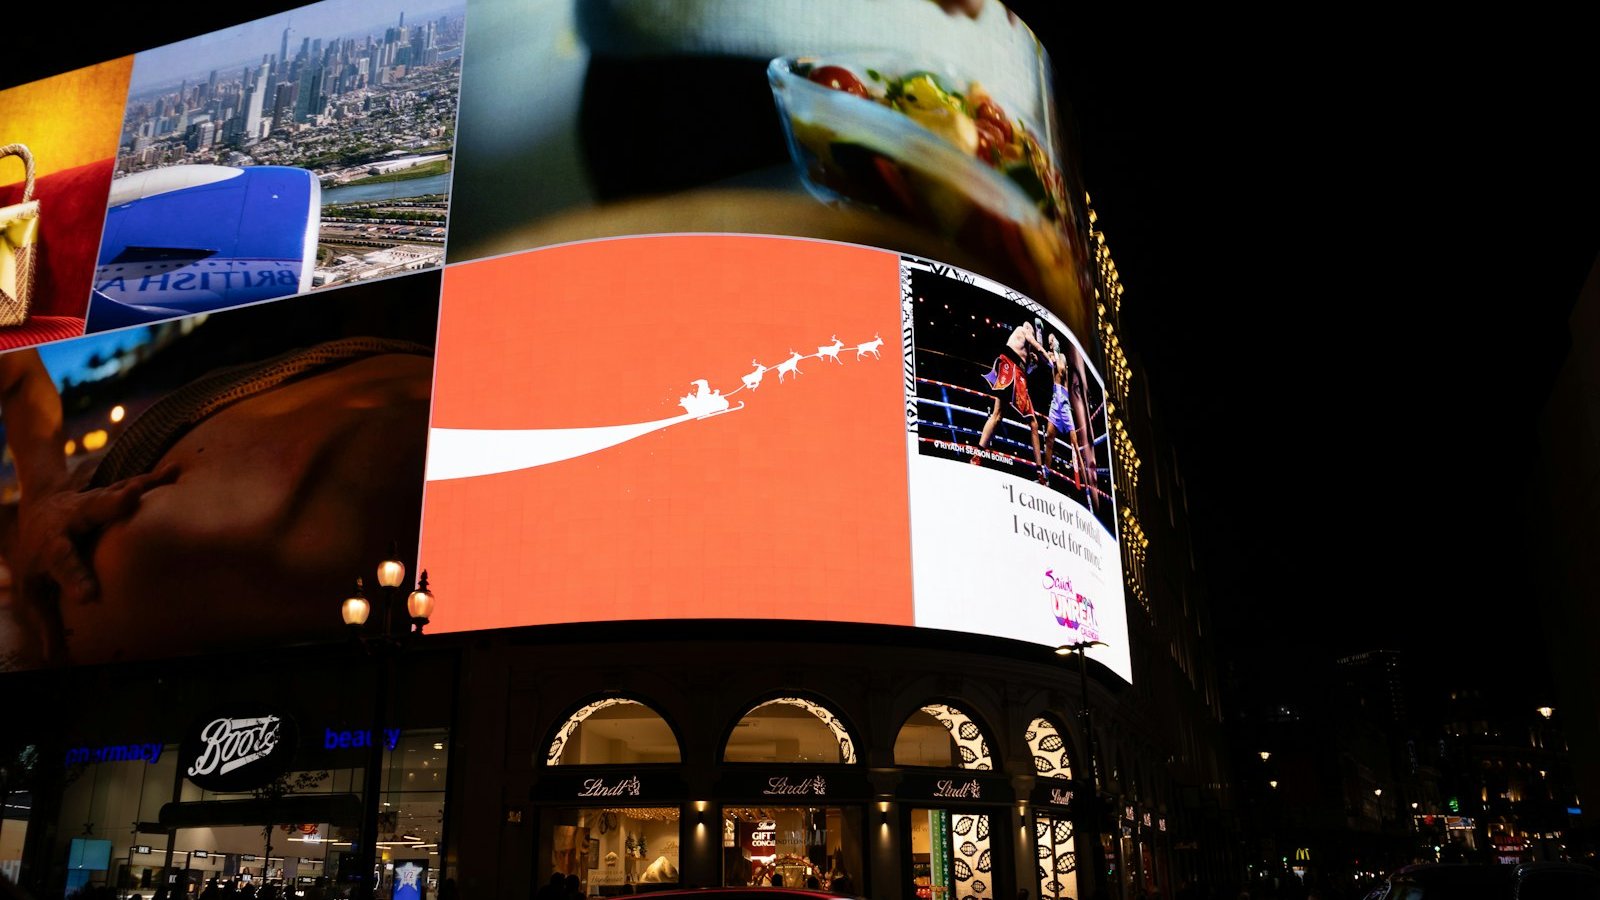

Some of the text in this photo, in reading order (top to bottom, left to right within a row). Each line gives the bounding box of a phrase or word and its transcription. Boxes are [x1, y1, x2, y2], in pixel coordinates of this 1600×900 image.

[940, 440, 1014, 466] RIYADH SEASON BOXING
[1019, 491, 1056, 517] came
[1058, 501, 1074, 526] for
[1013, 514, 1019, 534] I
[1023, 521, 1066, 549] stayed
[1067, 534, 1082, 557] for
[188, 715, 281, 777] Boots
[577, 777, 628, 798] Lindt
[763, 776, 814, 796] Lindt
[933, 780, 971, 799] Lindt
[752, 831, 771, 840] GIFT
